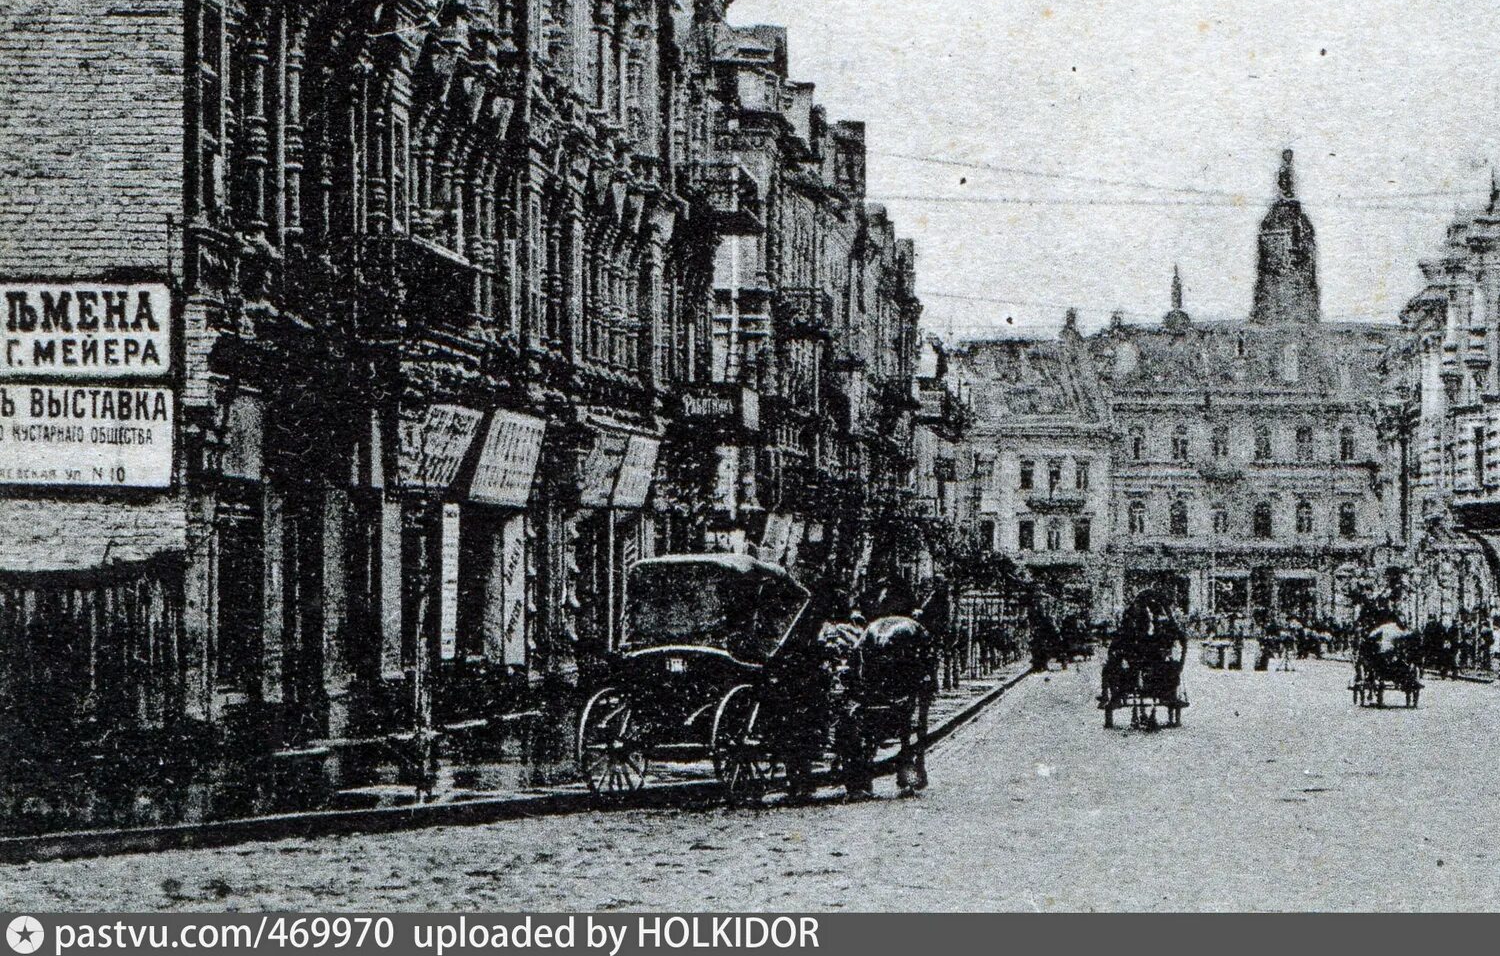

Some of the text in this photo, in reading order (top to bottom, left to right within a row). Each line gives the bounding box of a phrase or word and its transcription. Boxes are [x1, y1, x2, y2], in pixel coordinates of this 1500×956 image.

[33, 334, 161, 366] МЕЙЕРА
[30, 387, 168, 421] ВЫСТАВКА
[90, 426, 153, 445] ОБЩЕСТВА
[110, 466, 126, 483] 10
